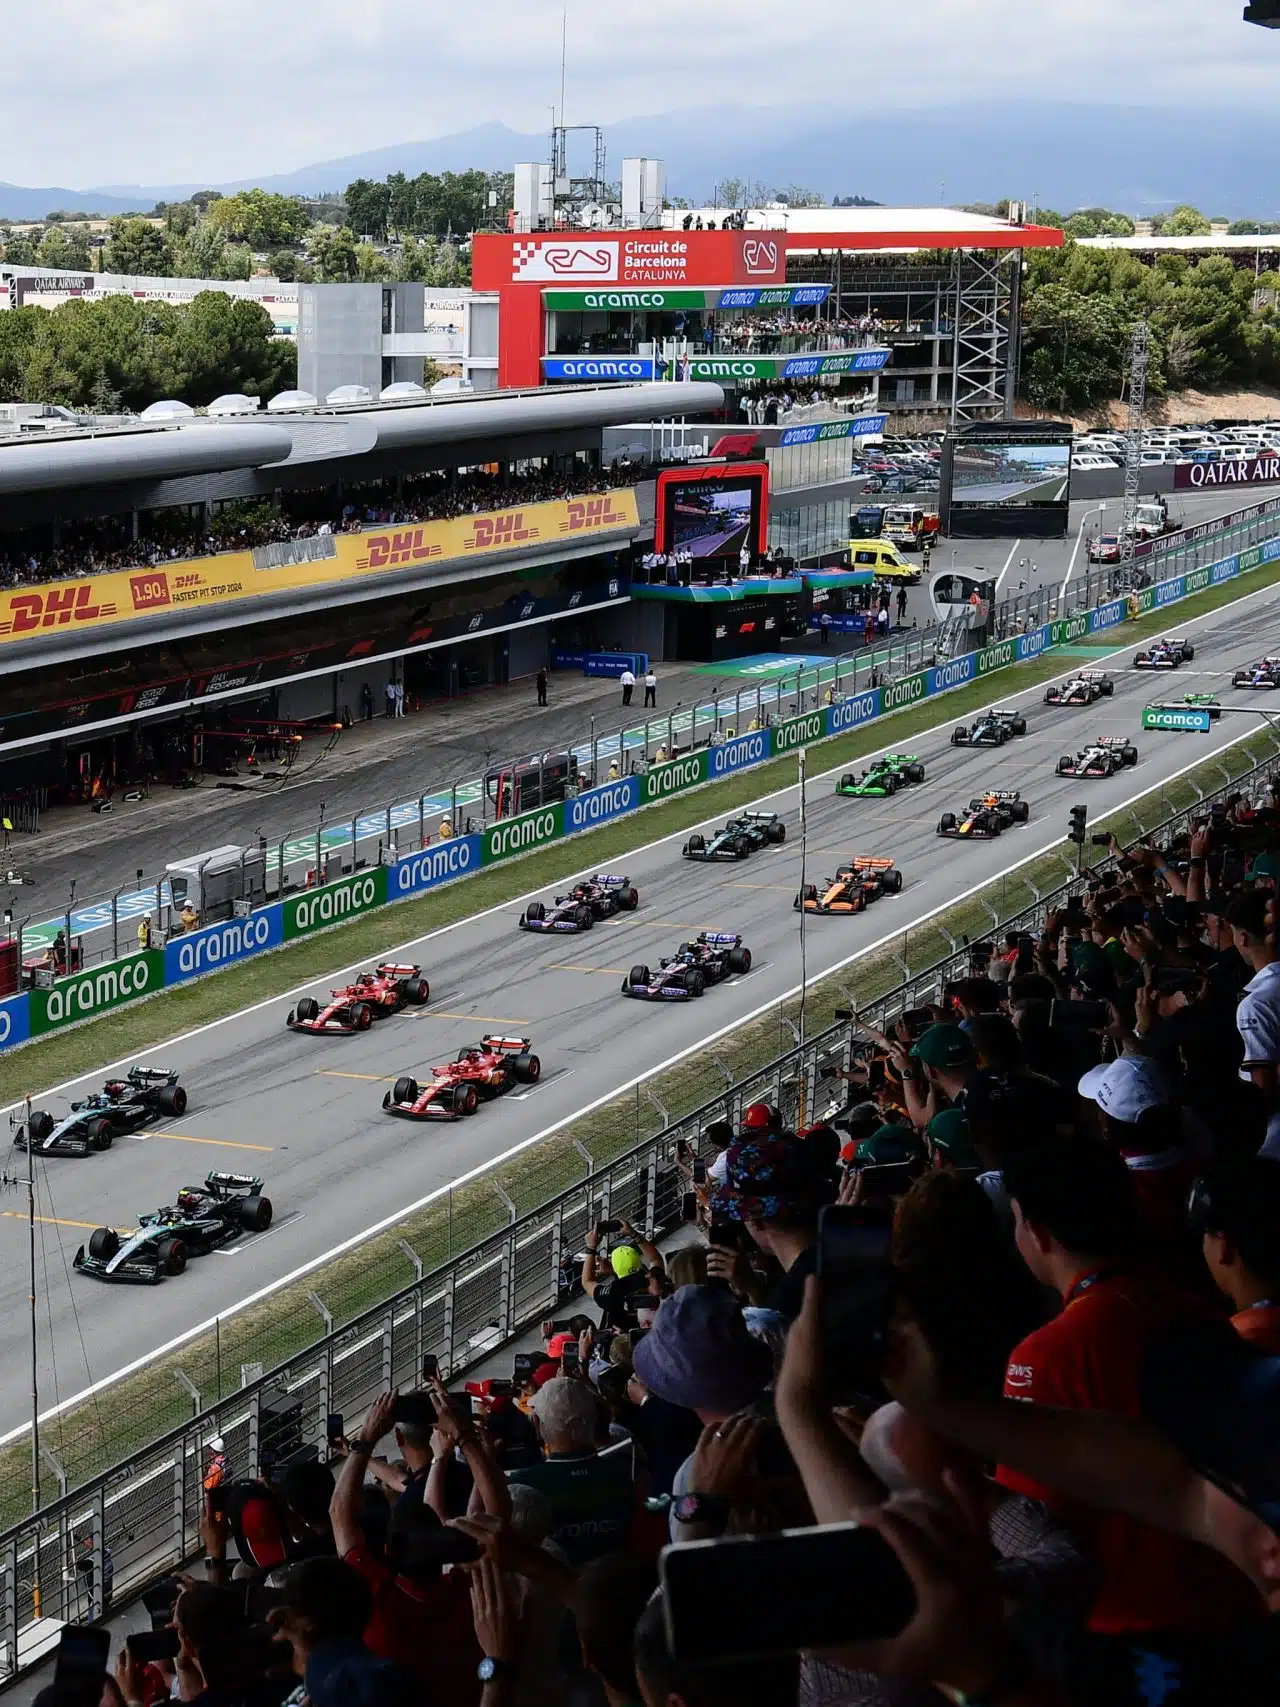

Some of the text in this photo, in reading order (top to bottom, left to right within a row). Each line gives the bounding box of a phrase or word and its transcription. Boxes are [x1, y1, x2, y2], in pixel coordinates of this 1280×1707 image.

[624, 241, 687, 254] Circuit de
[624, 256, 687, 268] Barcelona
[34, 278, 86, 290] QATAR AIRWAYS
[623, 269, 687, 281] CATALUNYA
[583, 292, 665, 307] aramco
[721, 289, 824, 305] aramco aramco aramco
[562, 362, 643, 376] aramco
[679, 362, 757, 376] ramco
[785, 354, 885, 375] aramco aramco aramco
[784, 418, 882, 443] aramco aramco aramco
[1189, 460, 1248, 487] QATAR
[567, 498, 618, 529] DHL
[472, 513, 529, 547] DHL
[367, 530, 432, 568] DHL
[1239, 550, 1260, 569] aramco
[174, 573, 201, 588] DHL
[1186, 571, 1209, 591] aramco
[1213, 560, 1235, 579] aramco
[172, 582, 243, 603] FASTEST PIT STOP 2024
[1157, 582, 1181, 602] aramco
[9, 584, 101, 632] DHL
[1093, 605, 1120, 628] aramco
[979, 644, 1012, 671] aramco
[935, 659, 970, 688] aramco
[884, 677, 922, 708] aramco
[832, 695, 874, 728] aramco
[1146, 713, 1204, 726] aramco
[776, 715, 820, 749] aramco
[715, 736, 763, 771] aramco
[647, 758, 700, 796] aramco
[572, 784, 631, 825] aramco
[490, 812, 555, 856] aramco
[398, 842, 470, 890] aramco
[295, 877, 375, 929] aramco
[179, 916, 269, 973] aramco
[46, 960, 149, 1022] aramco
[216, 1171, 255, 1182] PETRONAS
[1007, 1363, 1033, 1378] aws
